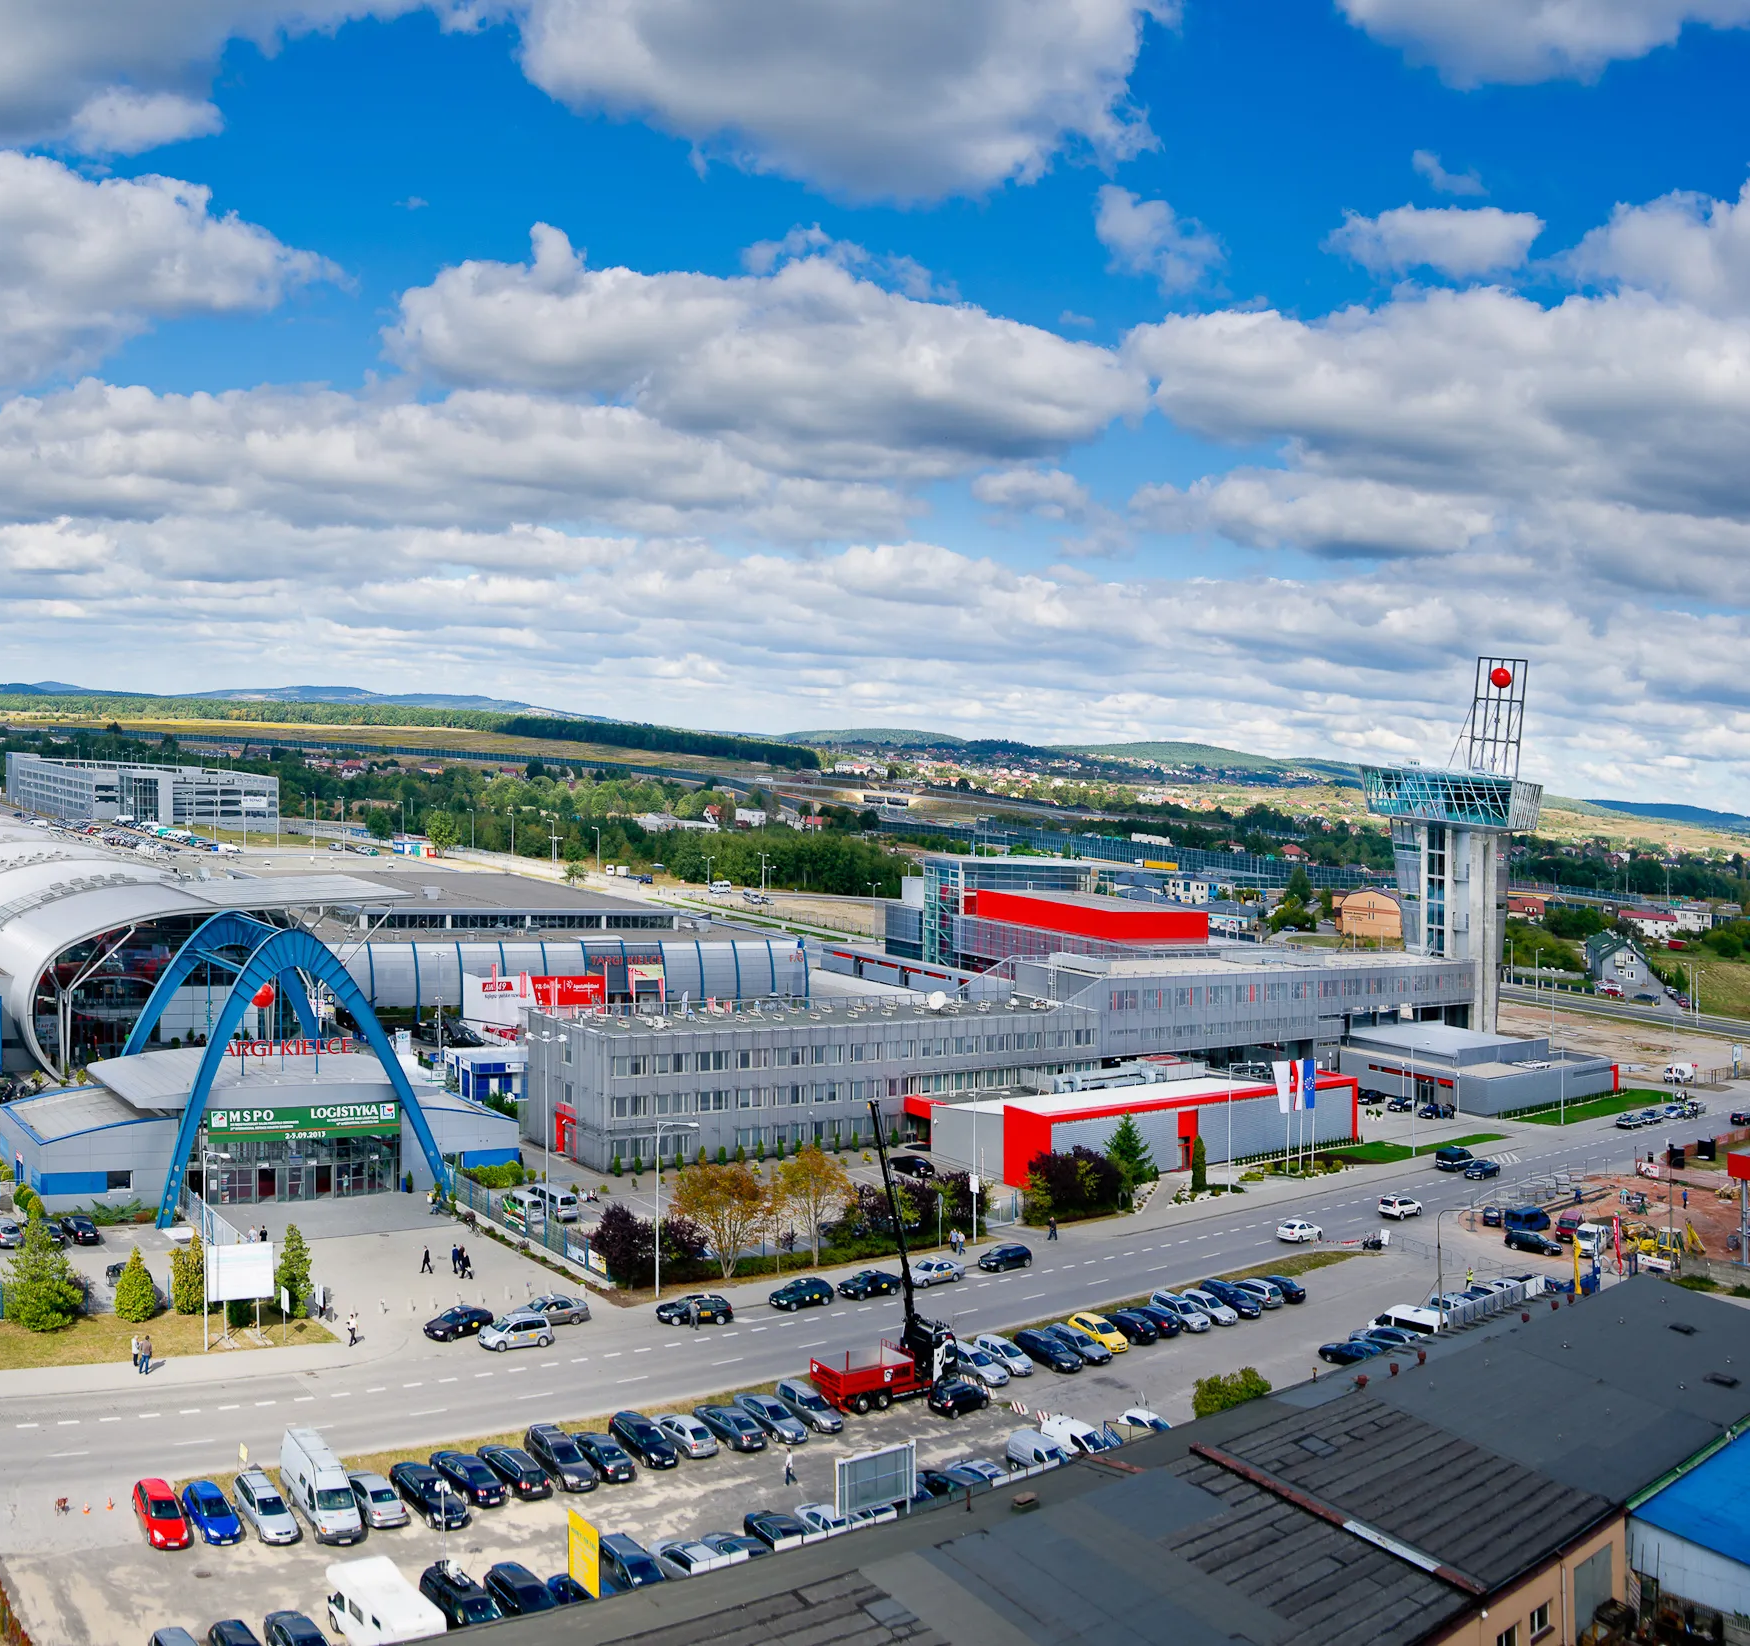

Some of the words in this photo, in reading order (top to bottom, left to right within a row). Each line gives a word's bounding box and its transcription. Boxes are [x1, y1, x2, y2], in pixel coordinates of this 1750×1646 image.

[591, 955, 623, 965] TARGI
[627, 955, 663, 965] KIELCE
[225, 1039, 273, 1057] ARGI
[281, 1037, 354, 1056] KIELCE
[310, 1104, 379, 1119] LOGISTYKA
